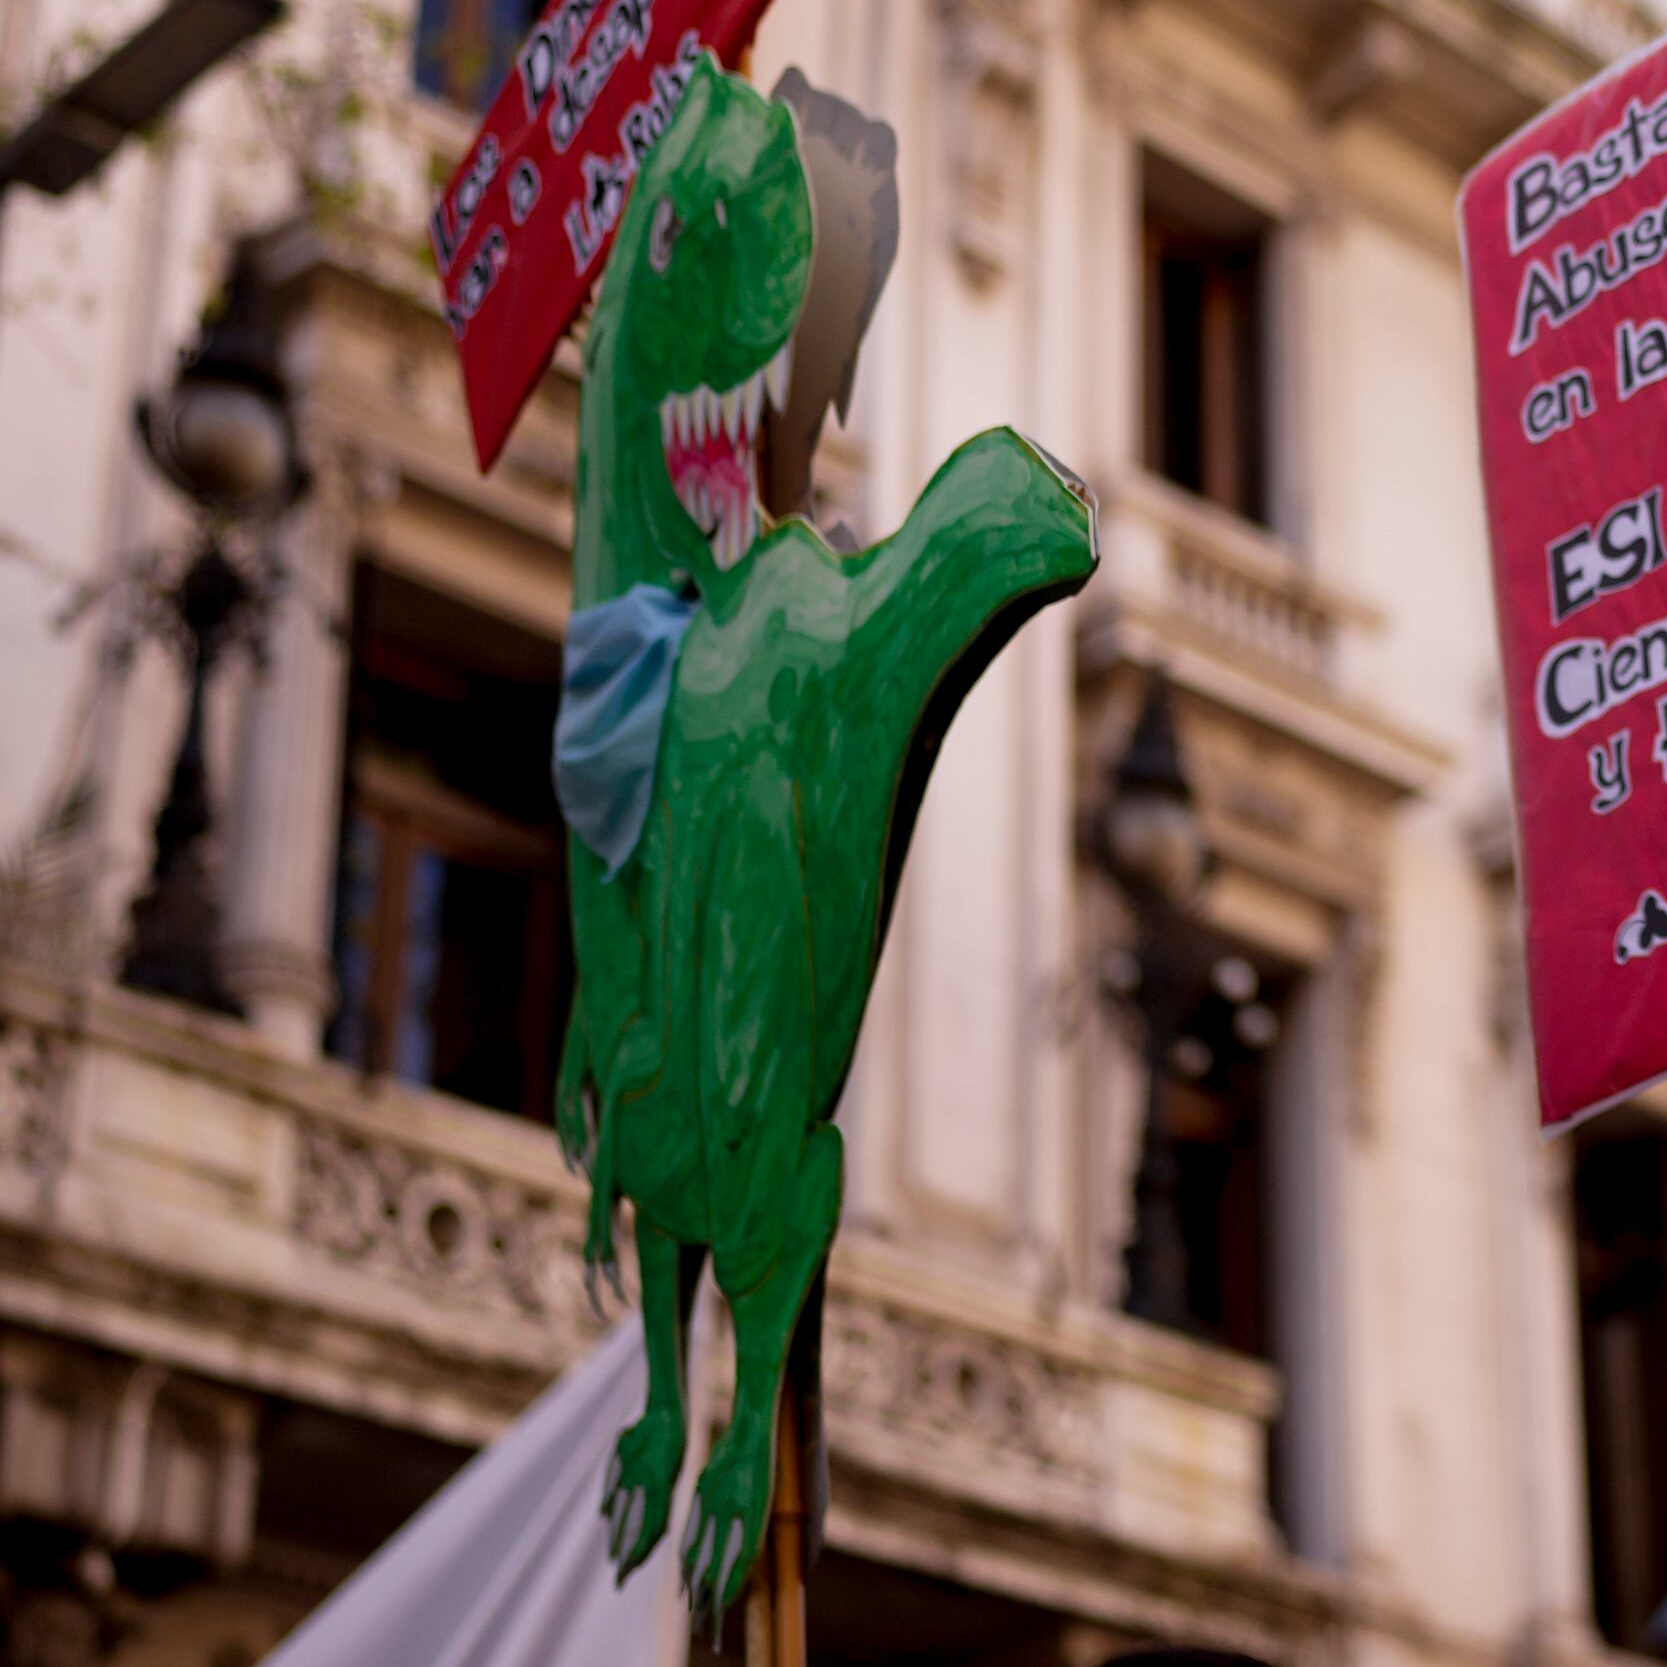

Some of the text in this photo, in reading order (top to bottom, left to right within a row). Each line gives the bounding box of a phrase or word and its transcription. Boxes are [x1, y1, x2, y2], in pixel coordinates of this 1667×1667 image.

[432, 133, 501, 276] Los
[507, 157, 541, 225] a
[1521, 367, 1597, 444] en
[1546, 487, 1667, 623] ESI
[1589, 730, 1630, 813] y
